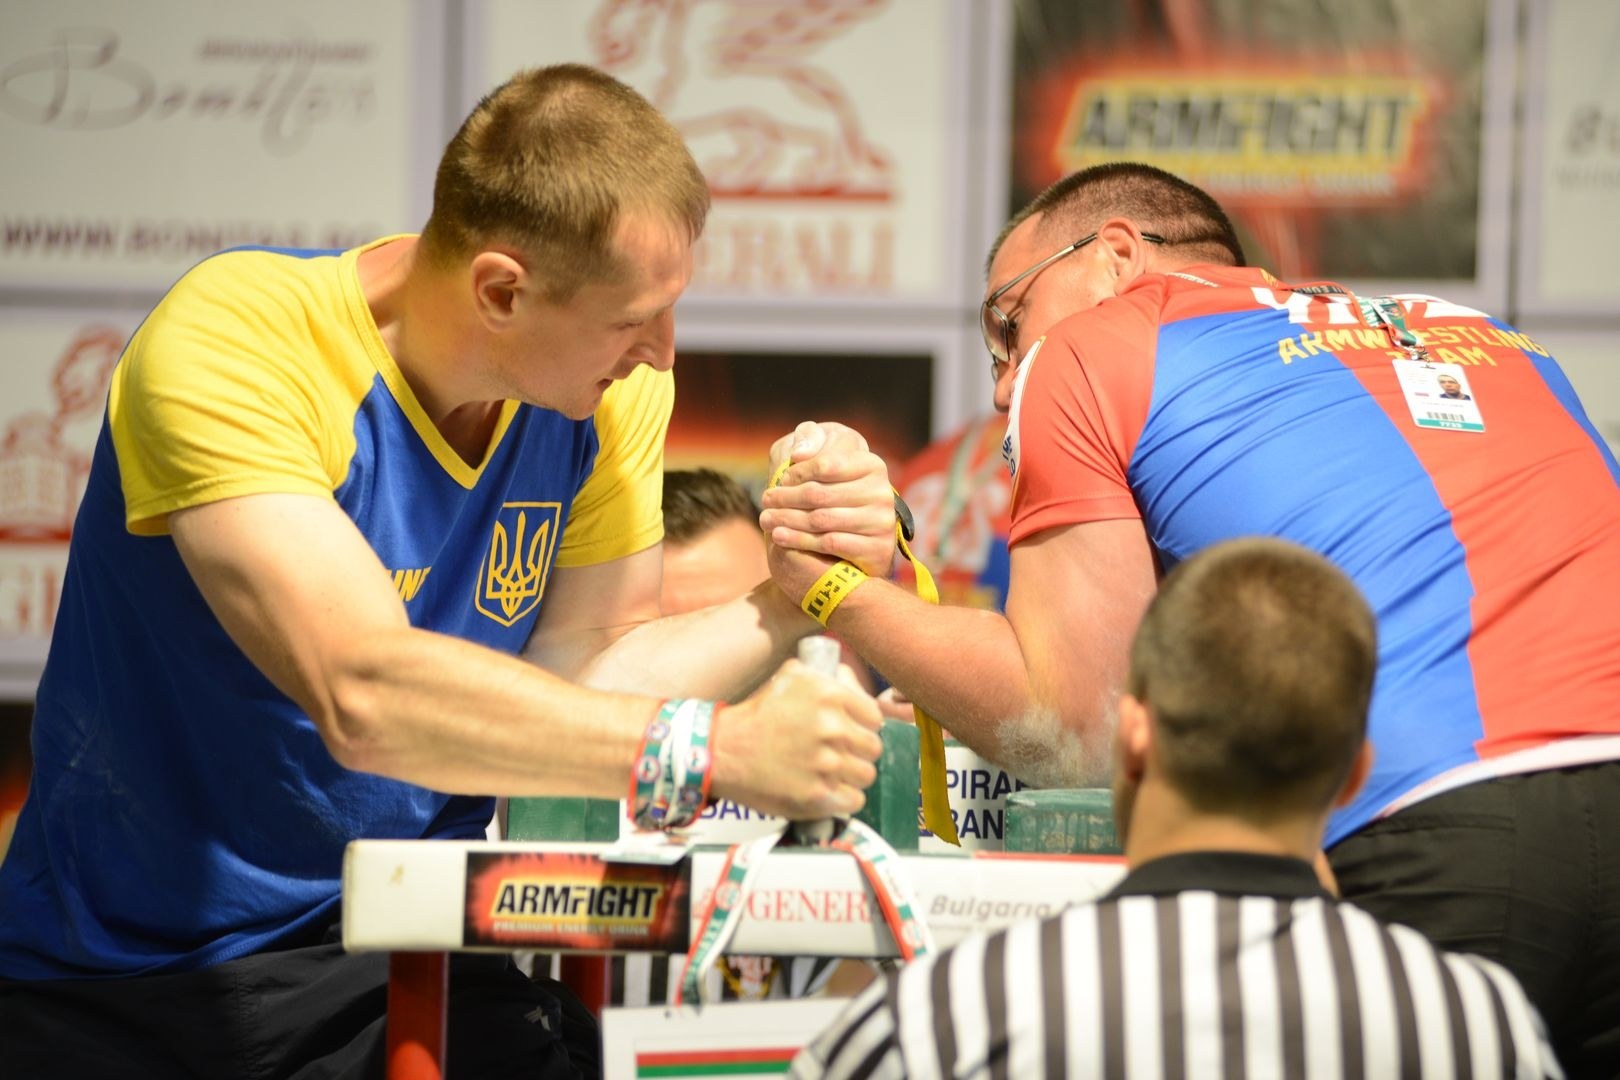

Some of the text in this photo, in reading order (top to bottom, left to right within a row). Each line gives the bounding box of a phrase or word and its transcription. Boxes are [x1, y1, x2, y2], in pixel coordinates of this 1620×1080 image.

[1278, 325, 1549, 365] ARMWESTLING
[496, 883, 659, 918] ARMFIGHT
[748, 887, 875, 925] GENER
[930, 894, 1050, 922] Bulgaria
